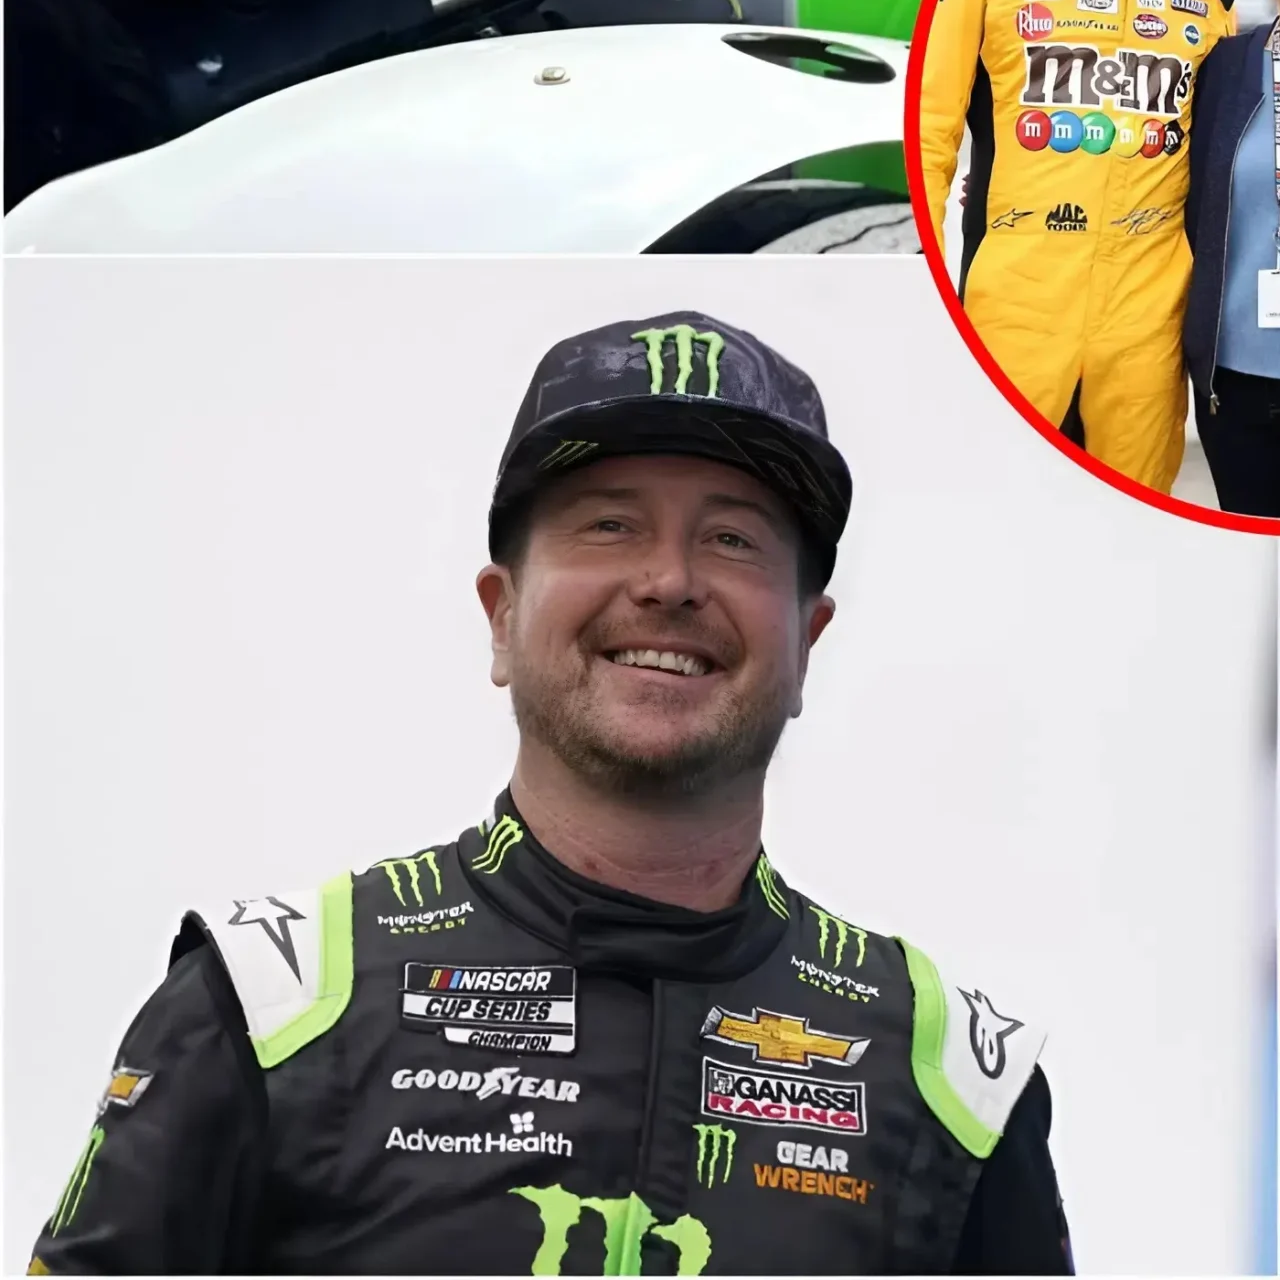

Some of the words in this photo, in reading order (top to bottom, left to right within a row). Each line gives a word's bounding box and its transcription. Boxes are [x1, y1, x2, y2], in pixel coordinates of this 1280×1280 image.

[459, 970, 552, 992] NASCAR
[425, 997, 472, 1019] CUP
[473, 1001, 552, 1021] SERIES
[468, 1031, 552, 1051] CHAMPION
[391, 1066, 581, 1103] GOODYEAR
[734, 1076, 856, 1113] GANASSI
[708, 1092, 860, 1129] RACING
[776, 1140, 849, 1173] GEAR
[753, 1163, 868, 1204] WRENCH
